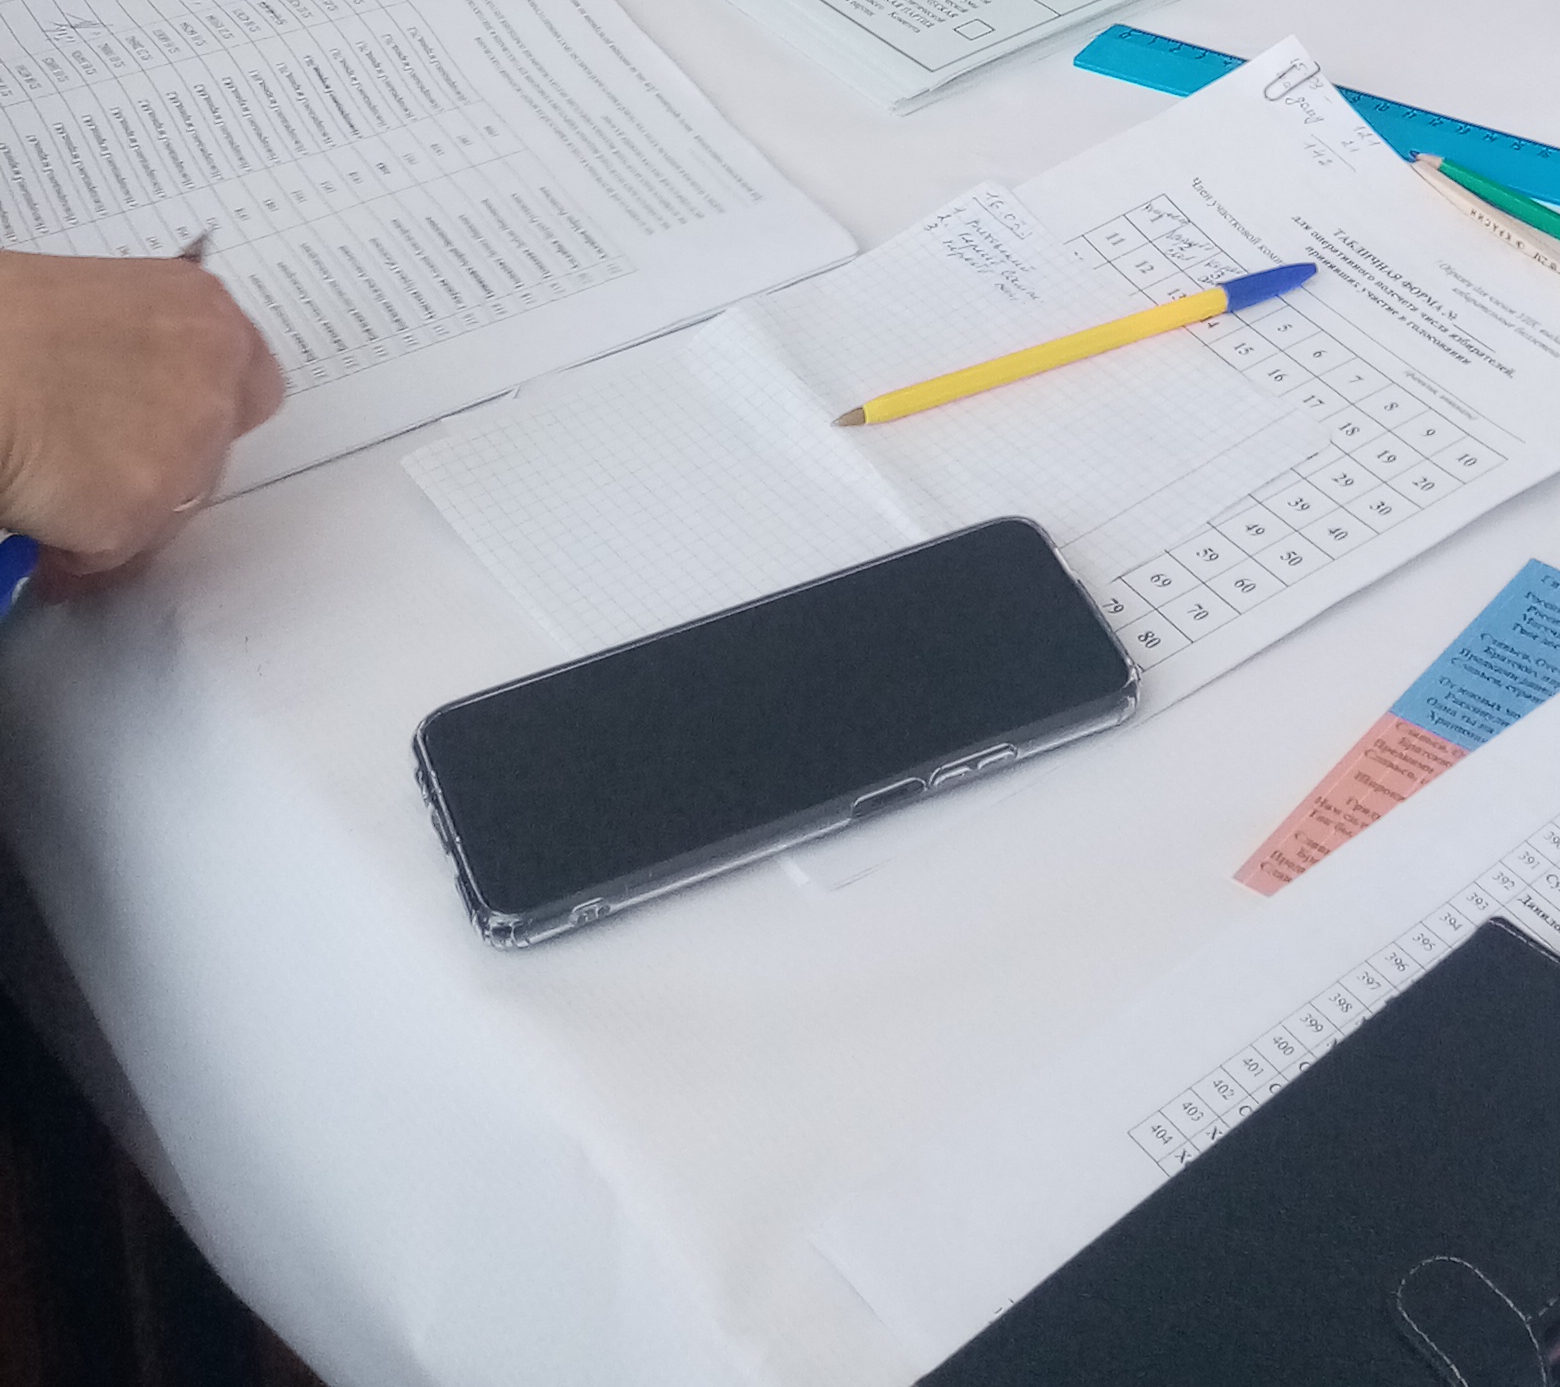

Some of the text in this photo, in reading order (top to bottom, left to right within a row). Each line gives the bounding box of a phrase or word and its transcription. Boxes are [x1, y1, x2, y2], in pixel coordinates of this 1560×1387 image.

[1192, 177, 1212, 201] Член
[1207, 200, 1262, 247] участковой
[1106, 232, 1126, 246] 11
[1135, 260, 1155, 275] 12
[1332, 228, 1403, 282] ТАБЛИЧНАЯ
[1401, 281, 1447, 313] ФОРМА
[1310, 231, 1375, 282] оперативного
[1420, 313, 1449, 333] числа
[1305, 246, 1360, 288] принявших
[1356, 287, 1400, 315] участие
[1406, 320, 1472, 365] голосовании
[1277, 323, 1294, 333] 5
[1233, 341, 1254, 356] 15
[1312, 349, 1327, 359] 6
[1267, 369, 1289, 383] 16
[1348, 375, 1364, 384] 7
[1301, 394, 1325, 408] 17
[1384, 402, 1399, 412] 8
[1338, 422, 1360, 437] 18
[1423, 428, 1437, 438] 9
[1375, 449, 1398, 464] 19
[1456, 453, 1478, 468] 10
[1331, 473, 1354, 488] 29
[1412, 477, 1435, 492] 20
[1287, 497, 1311, 512] 39
[1369, 501, 1393, 517] 30
[1245, 523, 1265, 537] 49
[1327, 527, 1349, 541] 40
[1196, 547, 1219, 562] 59
[1279, 551, 1303, 566] 50
[1150, 573, 1173, 588] 69
[1234, 578, 1257, 594] 60
[1102, 598, 1125, 615] 79
[1187, 604, 1210, 621] 70
[1138, 631, 1161, 649] 80
[1299, 1012, 1325, 1034] 399
[1272, 1034, 1295, 1057] 400
[1242, 1056, 1265, 1078] 401
[1212, 1078, 1235, 1100] 402
[1181, 1101, 1204, 1123] 403
[1149, 1123, 1174, 1145] 404
